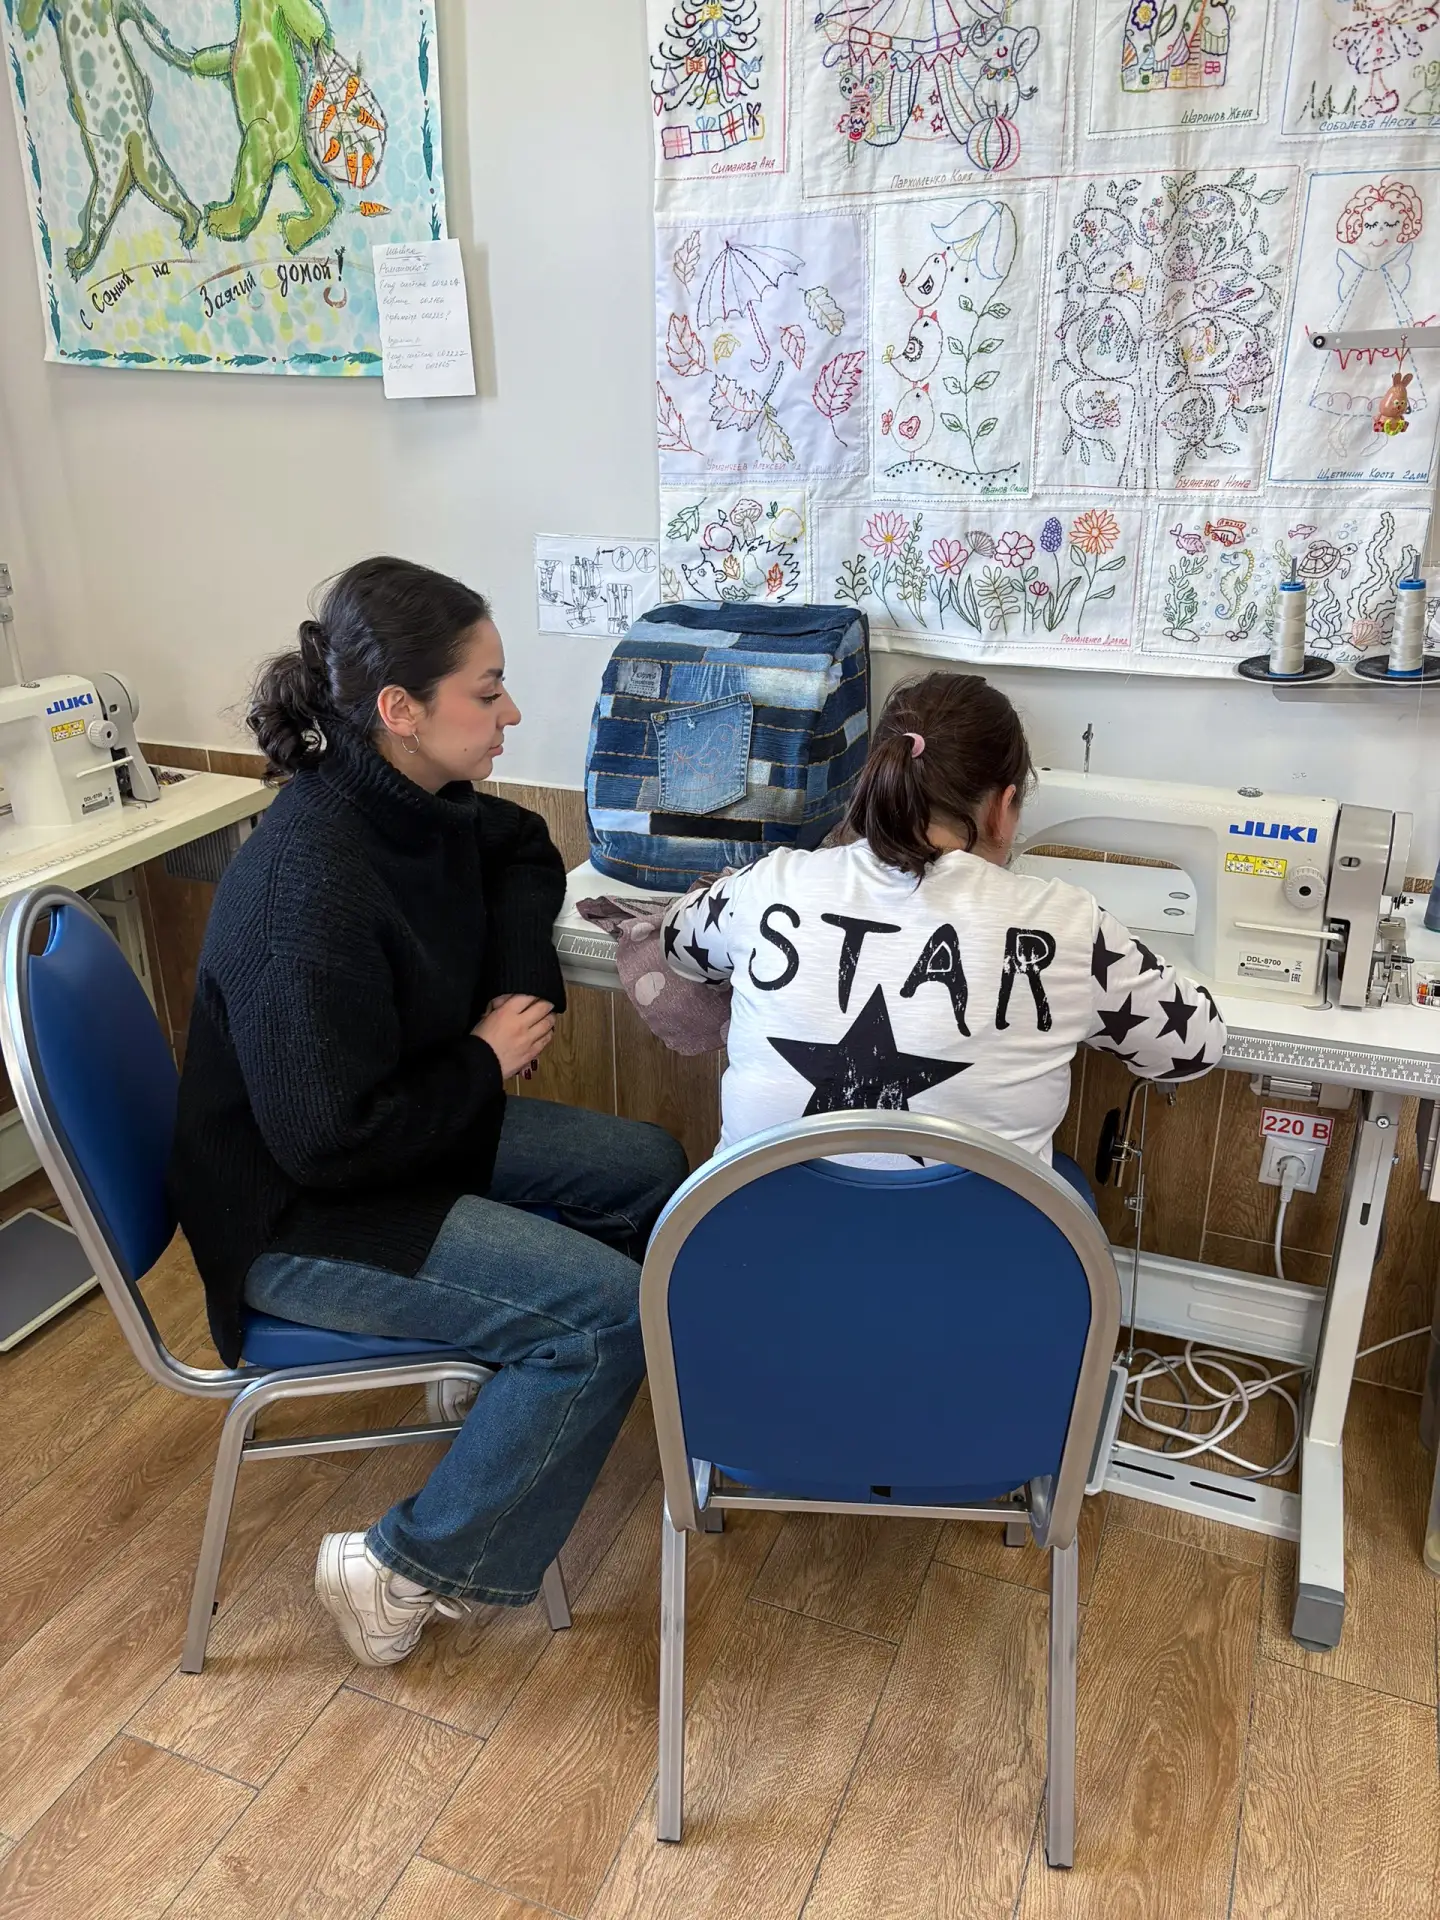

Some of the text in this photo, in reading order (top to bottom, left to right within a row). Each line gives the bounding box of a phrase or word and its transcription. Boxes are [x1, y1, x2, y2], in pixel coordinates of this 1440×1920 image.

[151, 262, 171, 278] на
[46, 693, 94, 715] JUKI
[1229, 820, 1318, 844] JUKI
[749, 903, 1056, 1037] STAR
[1246, 955, 1282, 966] DDL-8700
[1264, 1115, 1304, 1136] 220
